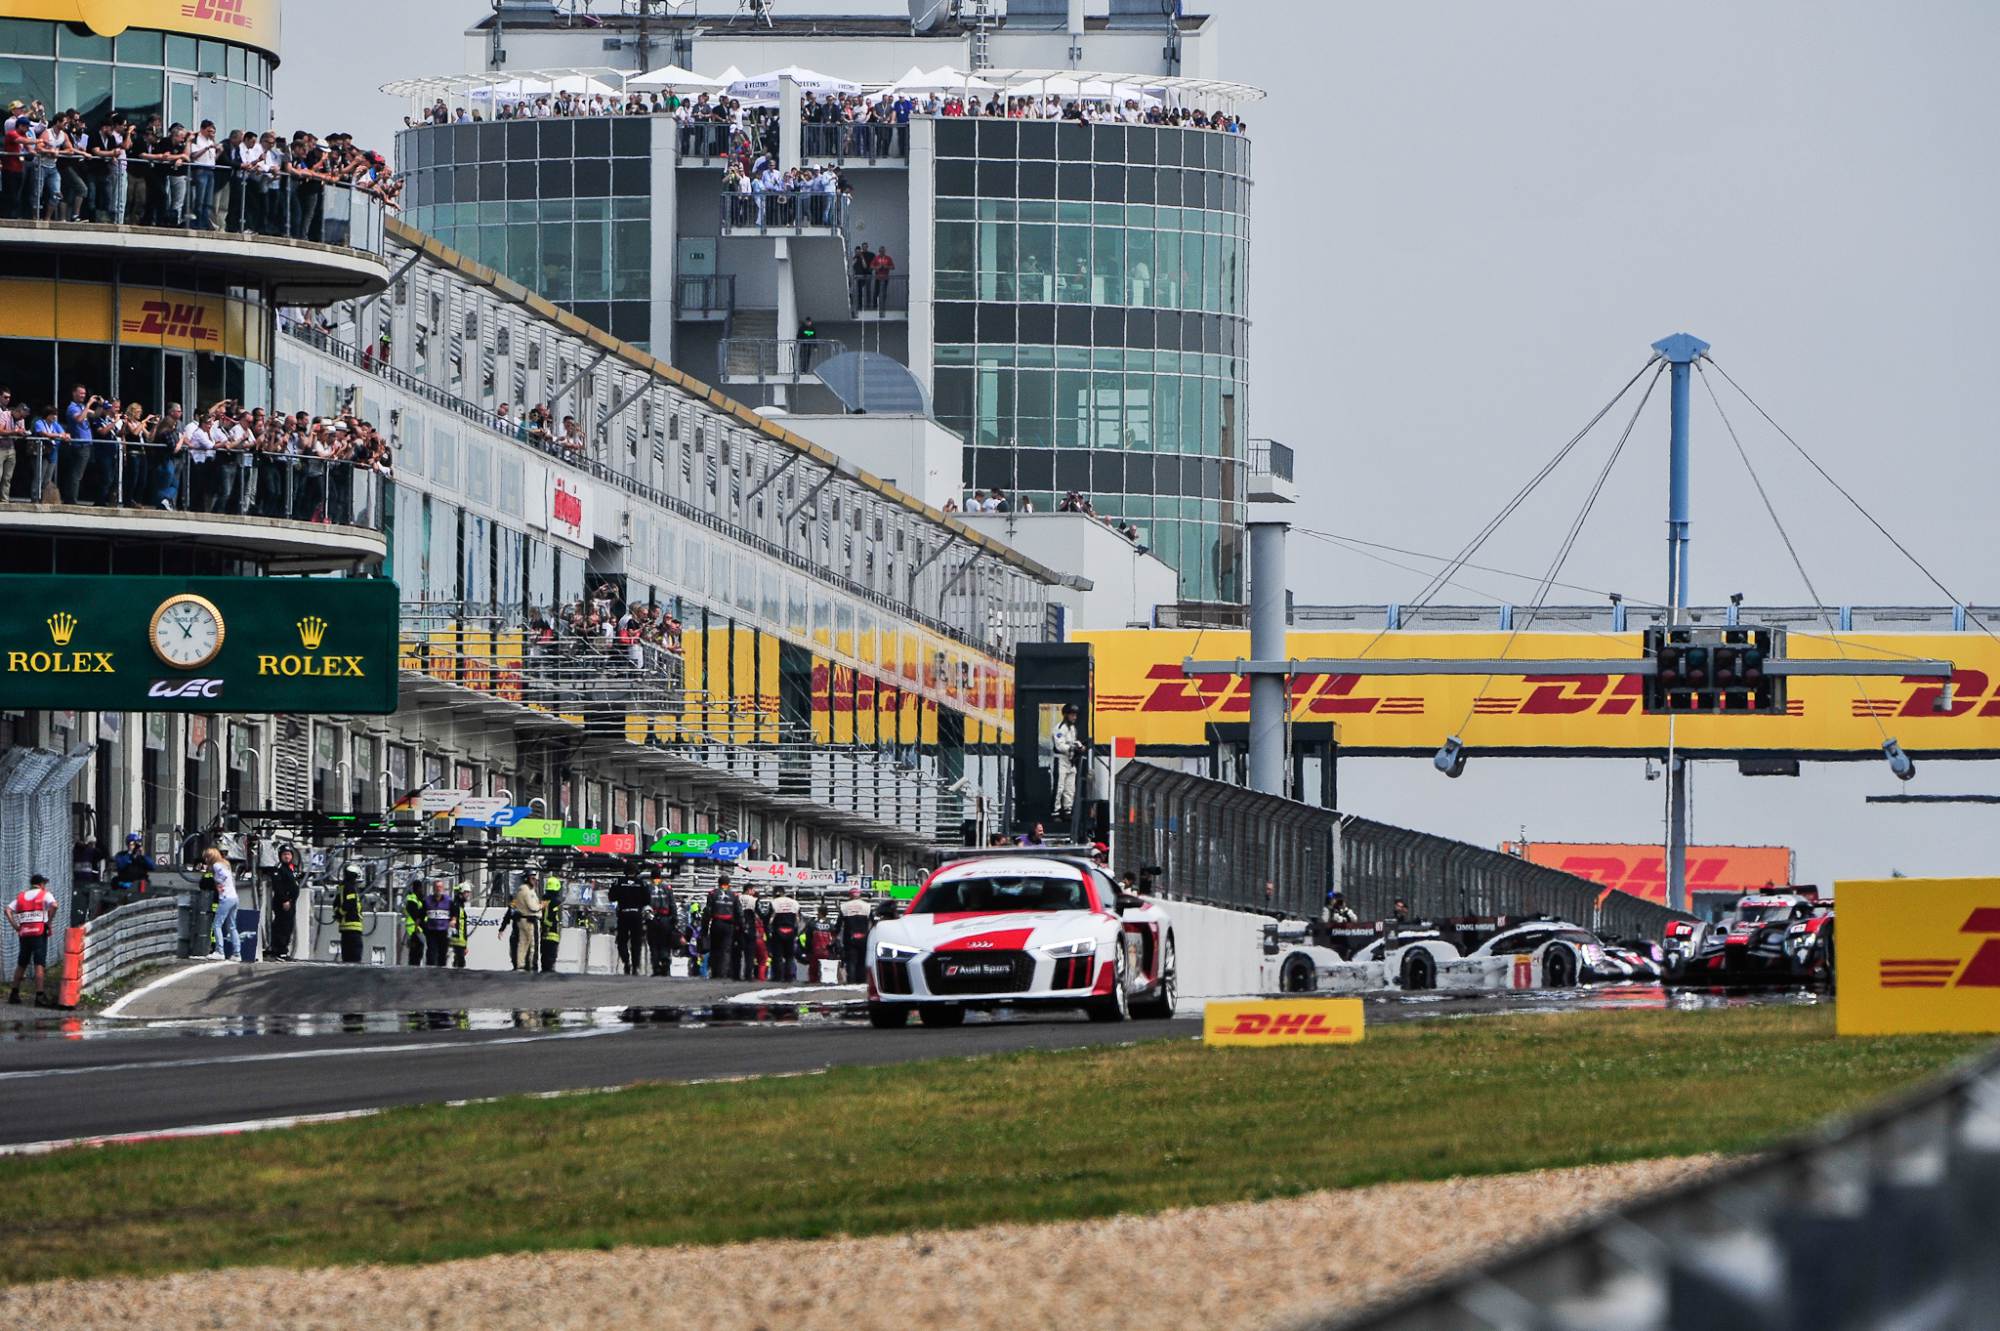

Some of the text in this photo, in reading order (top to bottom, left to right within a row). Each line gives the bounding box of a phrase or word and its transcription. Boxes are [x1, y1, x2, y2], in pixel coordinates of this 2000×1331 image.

[140, 301, 208, 340] DHL
[8, 651, 116, 673] ROLEX
[258, 655, 365, 677] ROLEX
[148, 679, 224, 697] WEC
[543, 823, 559, 835] 97
[582, 833, 598, 844] 98
[615, 839, 632, 850] 95
[768, 864, 785, 876] 44
[837, 871, 845, 883] 5
[862, 878, 870, 889] 6
[960, 965, 981, 974] Audi
[1233, 1014, 1333, 1035] DHL
